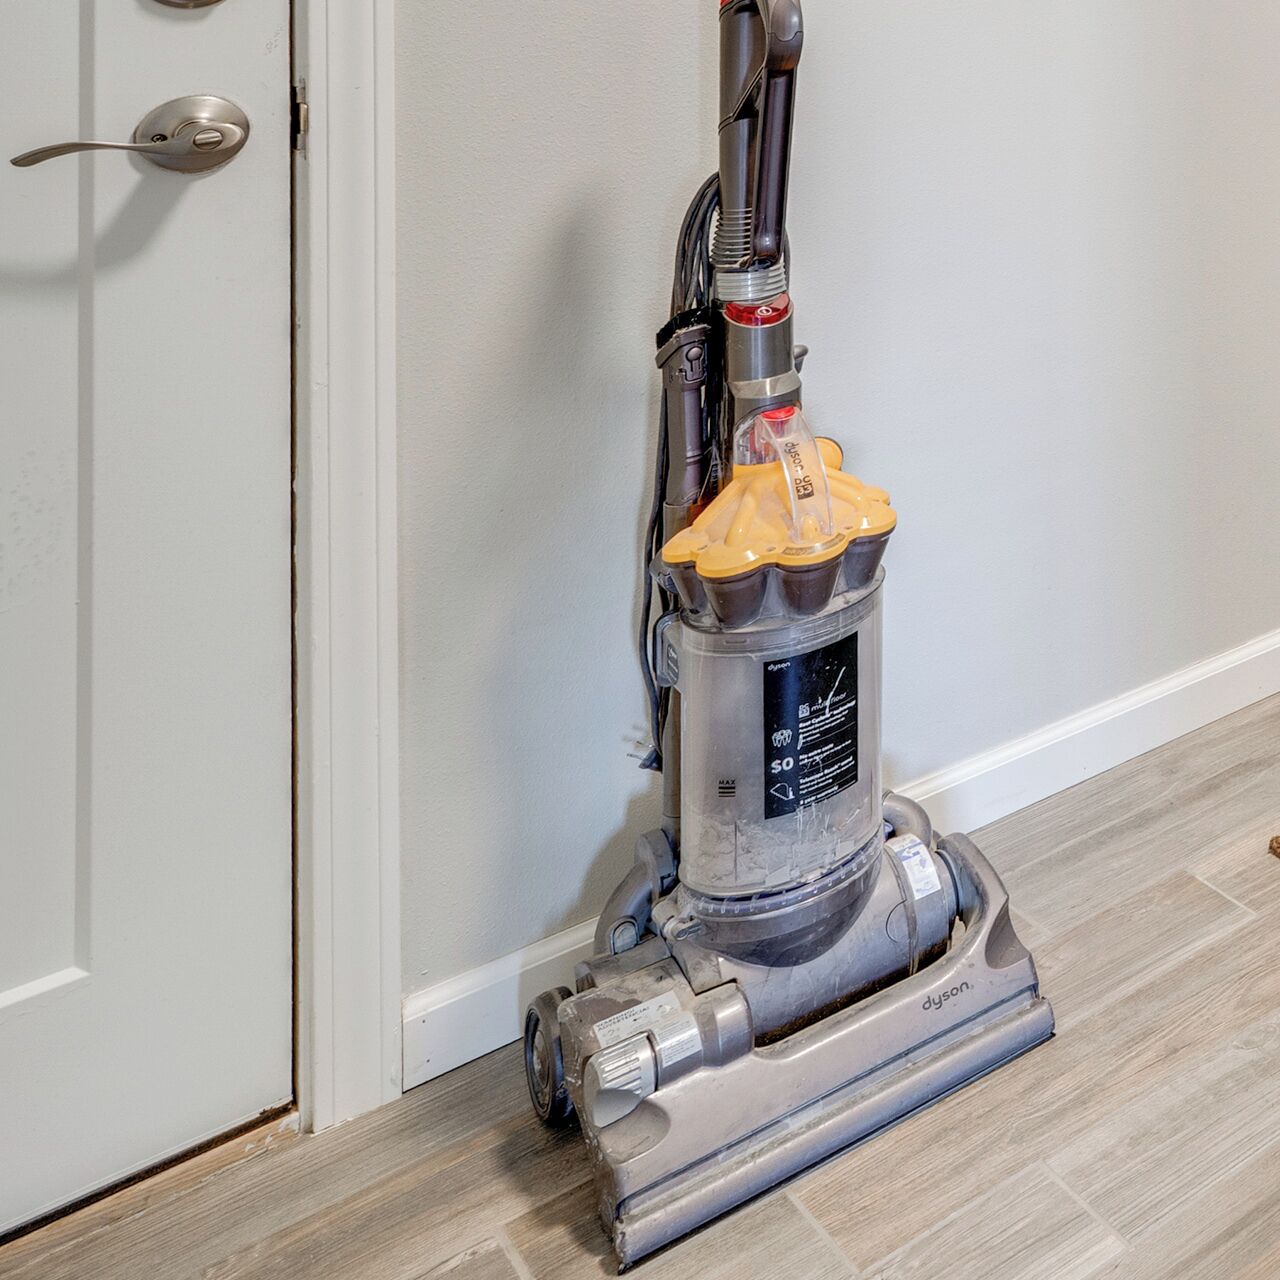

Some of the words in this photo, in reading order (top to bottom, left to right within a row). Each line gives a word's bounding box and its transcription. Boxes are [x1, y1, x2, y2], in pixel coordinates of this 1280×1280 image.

[784, 441, 804, 472] dyson
[767, 661, 791, 671] dyson
[771, 757, 794, 773] $0
[922, 981, 970, 1011] dyson
